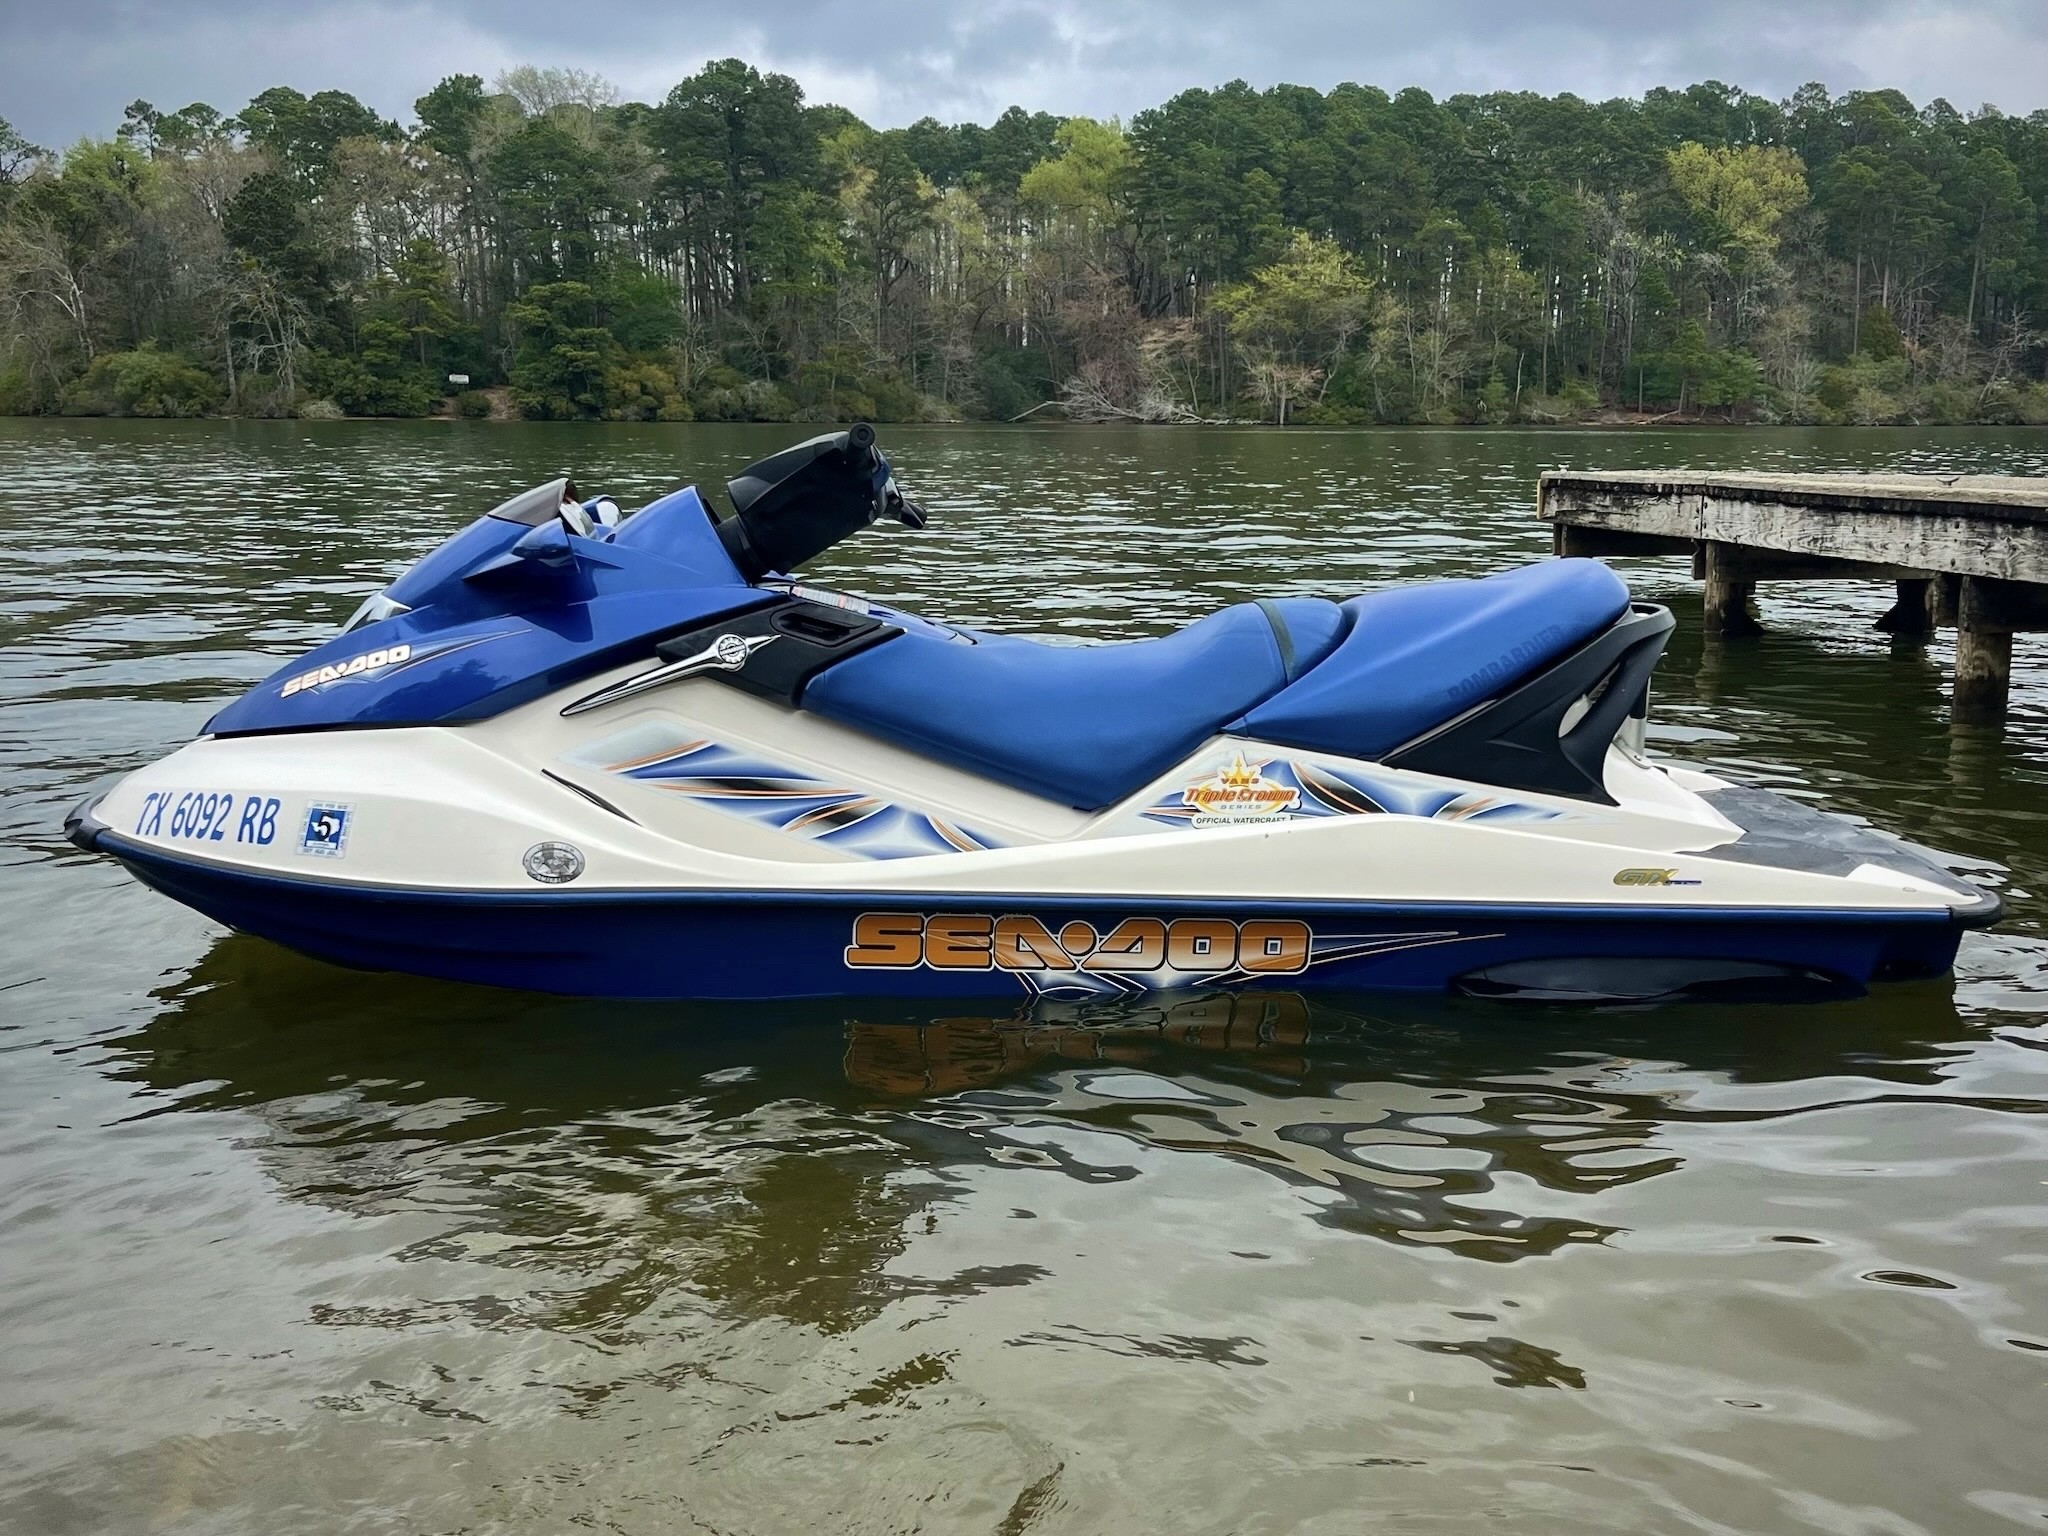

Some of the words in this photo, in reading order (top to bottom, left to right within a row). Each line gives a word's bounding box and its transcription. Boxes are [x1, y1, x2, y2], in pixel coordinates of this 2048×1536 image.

[1447, 624, 1562, 700] BOMBARDIER
[1186, 787, 1237, 804] Triple
[1237, 788, 1297, 802] Crown
[135, 792, 173, 836] TX
[171, 792, 233, 841] 6092
[237, 796, 281, 845] RB
[314, 811, 331, 842] 5
[1613, 868, 1680, 886] GTX
